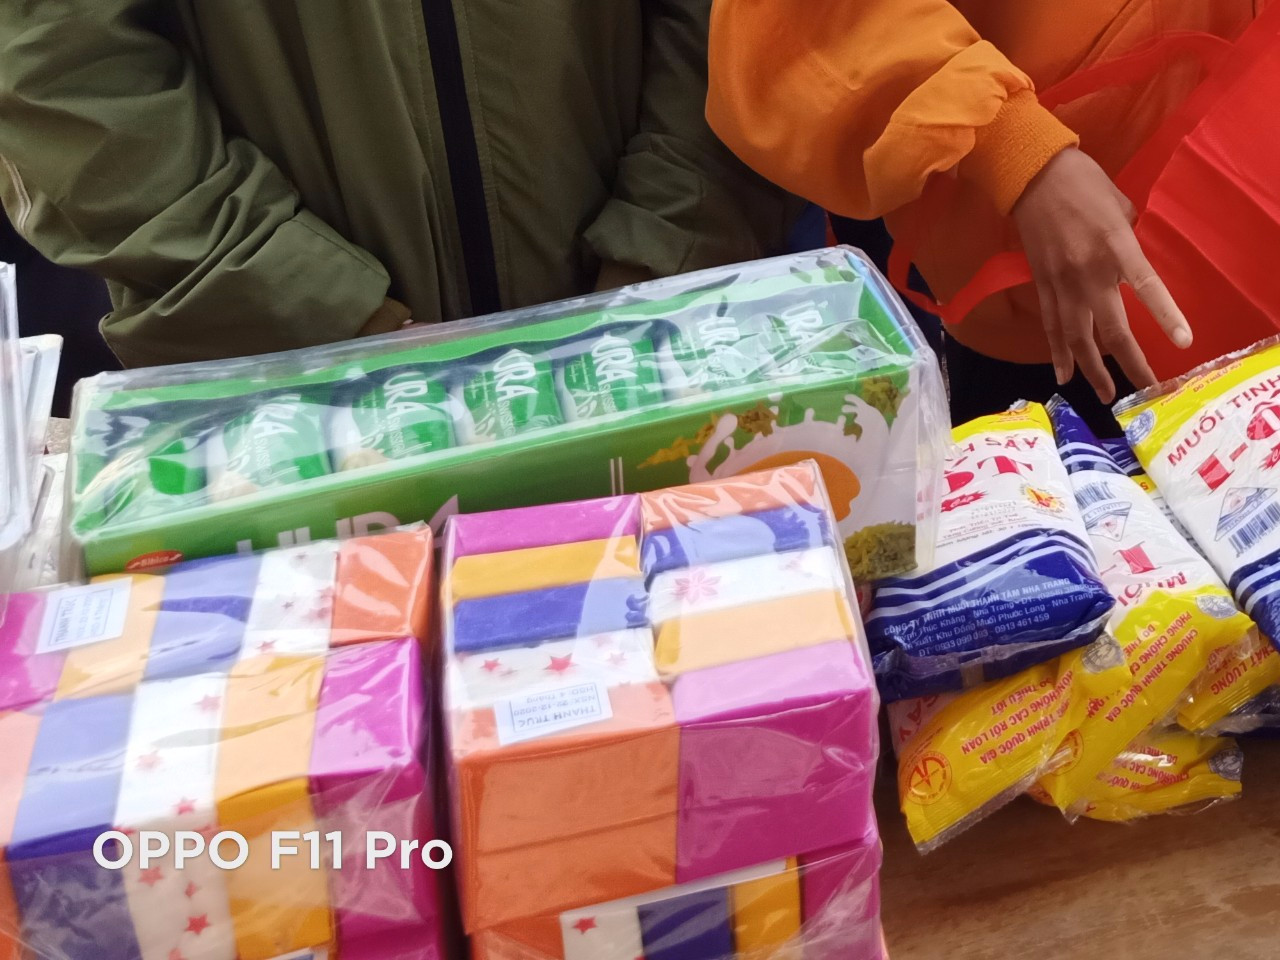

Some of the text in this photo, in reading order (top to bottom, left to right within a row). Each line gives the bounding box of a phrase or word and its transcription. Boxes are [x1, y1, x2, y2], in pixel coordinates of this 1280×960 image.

[493, 350, 539, 400] URA
[383, 372, 433, 418] URA
[1167, 408, 1225, 466] MUỐI
[1025, 603, 1046, 617] Long
[1052, 596, 1069, 608] Nha
[1070, 590, 1094, 604] Trang
[994, 622, 1016, 634] 0913
[1017, 617, 1033, 629] 461
[1033, 612, 1050, 624] 459
[1168, 628, 1199, 662] CHƯƠNG
[1142, 660, 1168, 688] TRÌNH
[1121, 684, 1143, 709] QUỐC
[553, 705, 596, 720] THANH
[1008, 711, 1030, 729] CÁC
[1104, 705, 1122, 723] GIA
[985, 725, 1008, 742] RỐI
[1000, 732, 1027, 755] QUỐC
[961, 738, 985, 756] LOẠN
[979, 751, 998, 766] GIA
